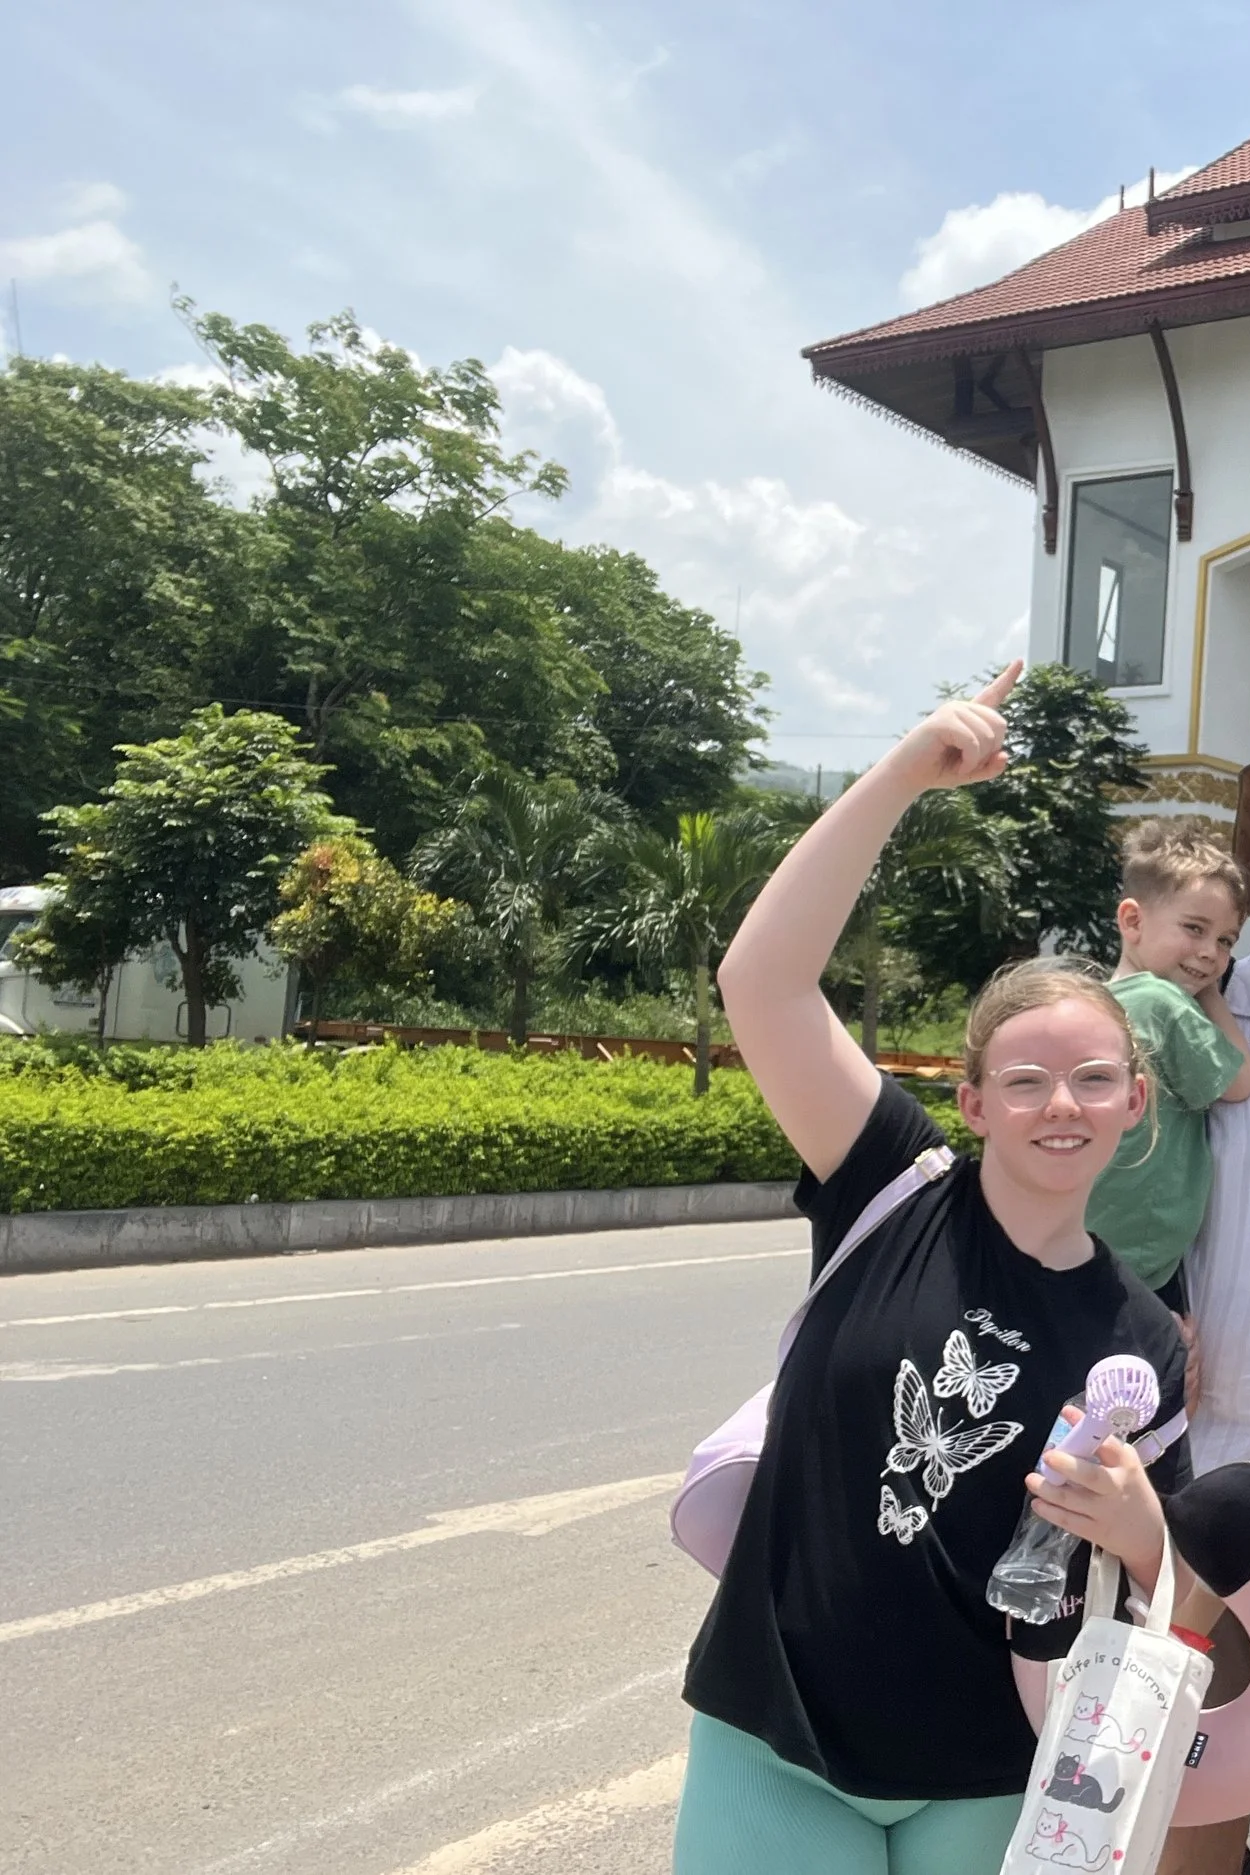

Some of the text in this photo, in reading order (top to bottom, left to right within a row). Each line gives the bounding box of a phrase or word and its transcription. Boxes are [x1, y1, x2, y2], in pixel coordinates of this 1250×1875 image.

[963, 1307, 1032, 1352] Papillon
[1062, 1652, 1169, 1711] Life is a journey
